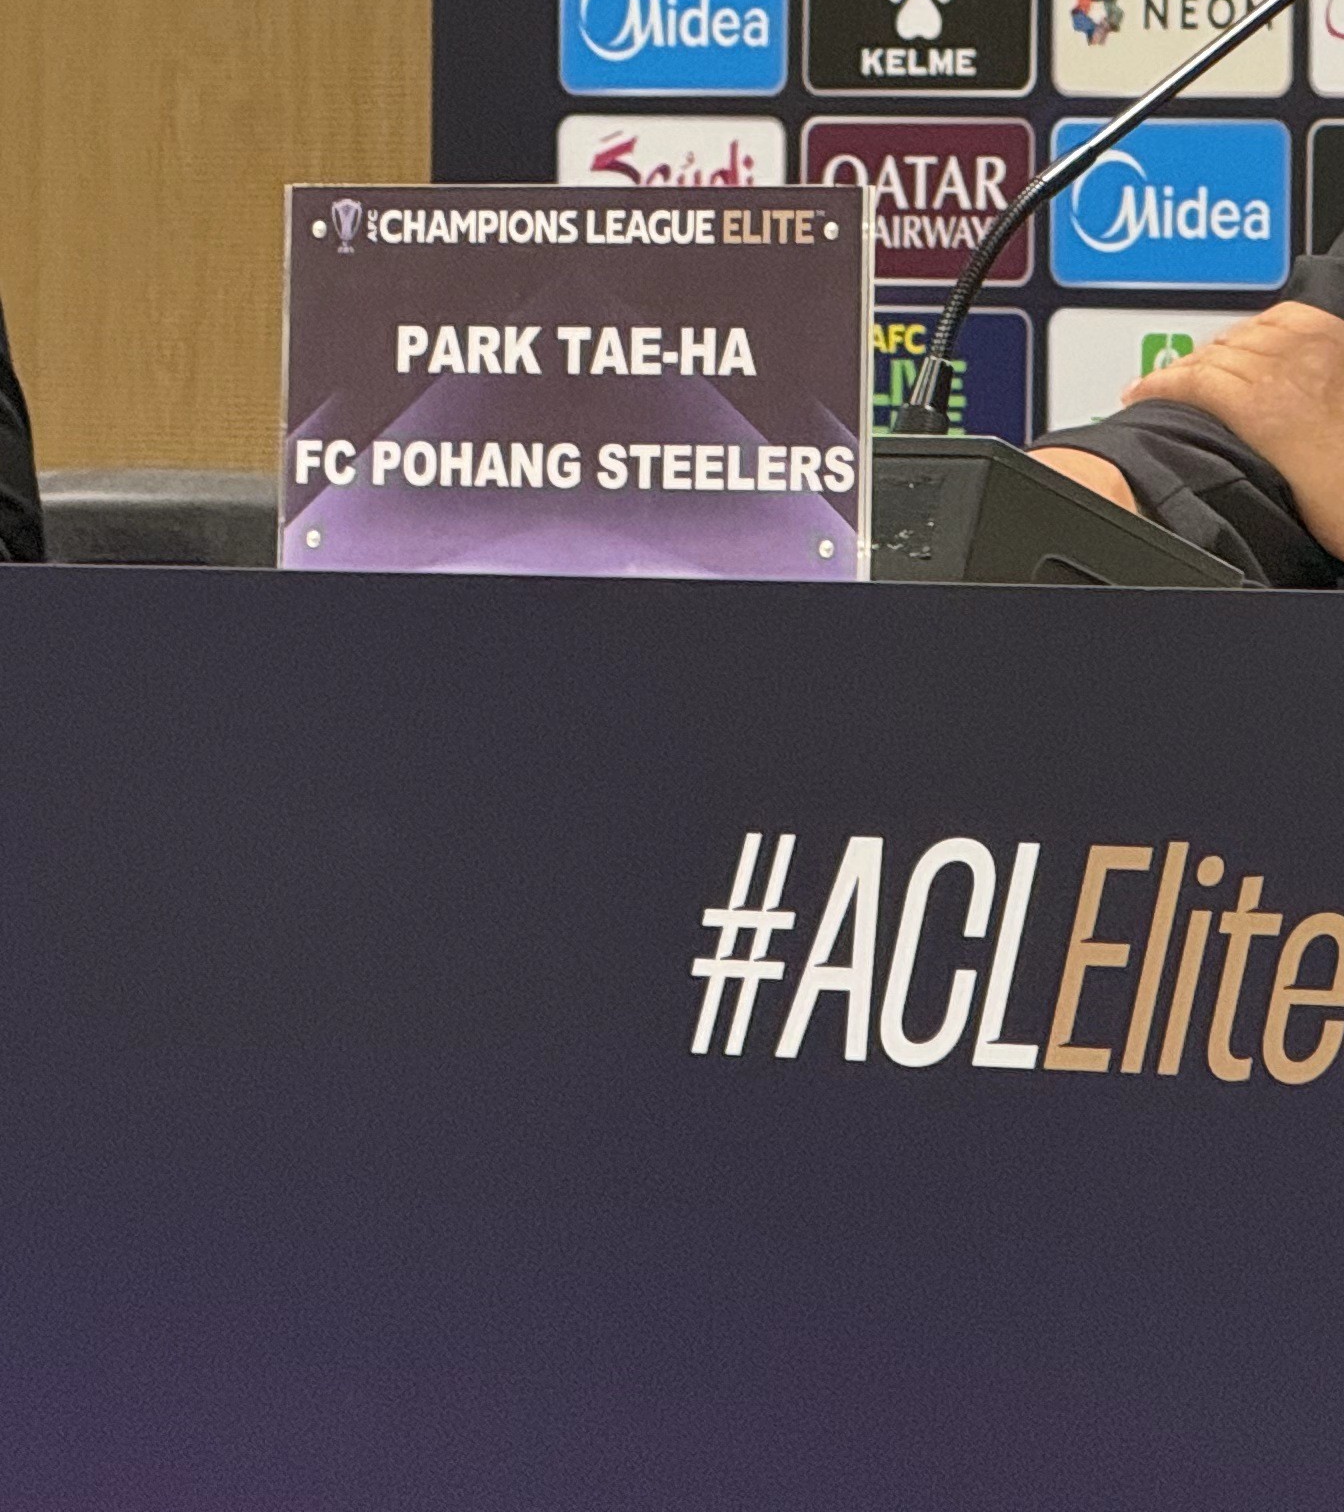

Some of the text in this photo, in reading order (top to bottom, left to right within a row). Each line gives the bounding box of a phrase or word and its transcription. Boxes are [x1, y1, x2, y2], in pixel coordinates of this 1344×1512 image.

[861, 48, 977, 76] KELME
[380, 209, 579, 245] CHAMPIONS
[586, 210, 715, 244] LEAGUE
[1081, 178, 1271, 244] Midea
[874, 215, 996, 249] AIRWAY
[396, 324, 757, 377] PARK TAE-HA
[872, 323, 927, 355] AFC
[295, 439, 856, 493] FC POHANG STEELERS
